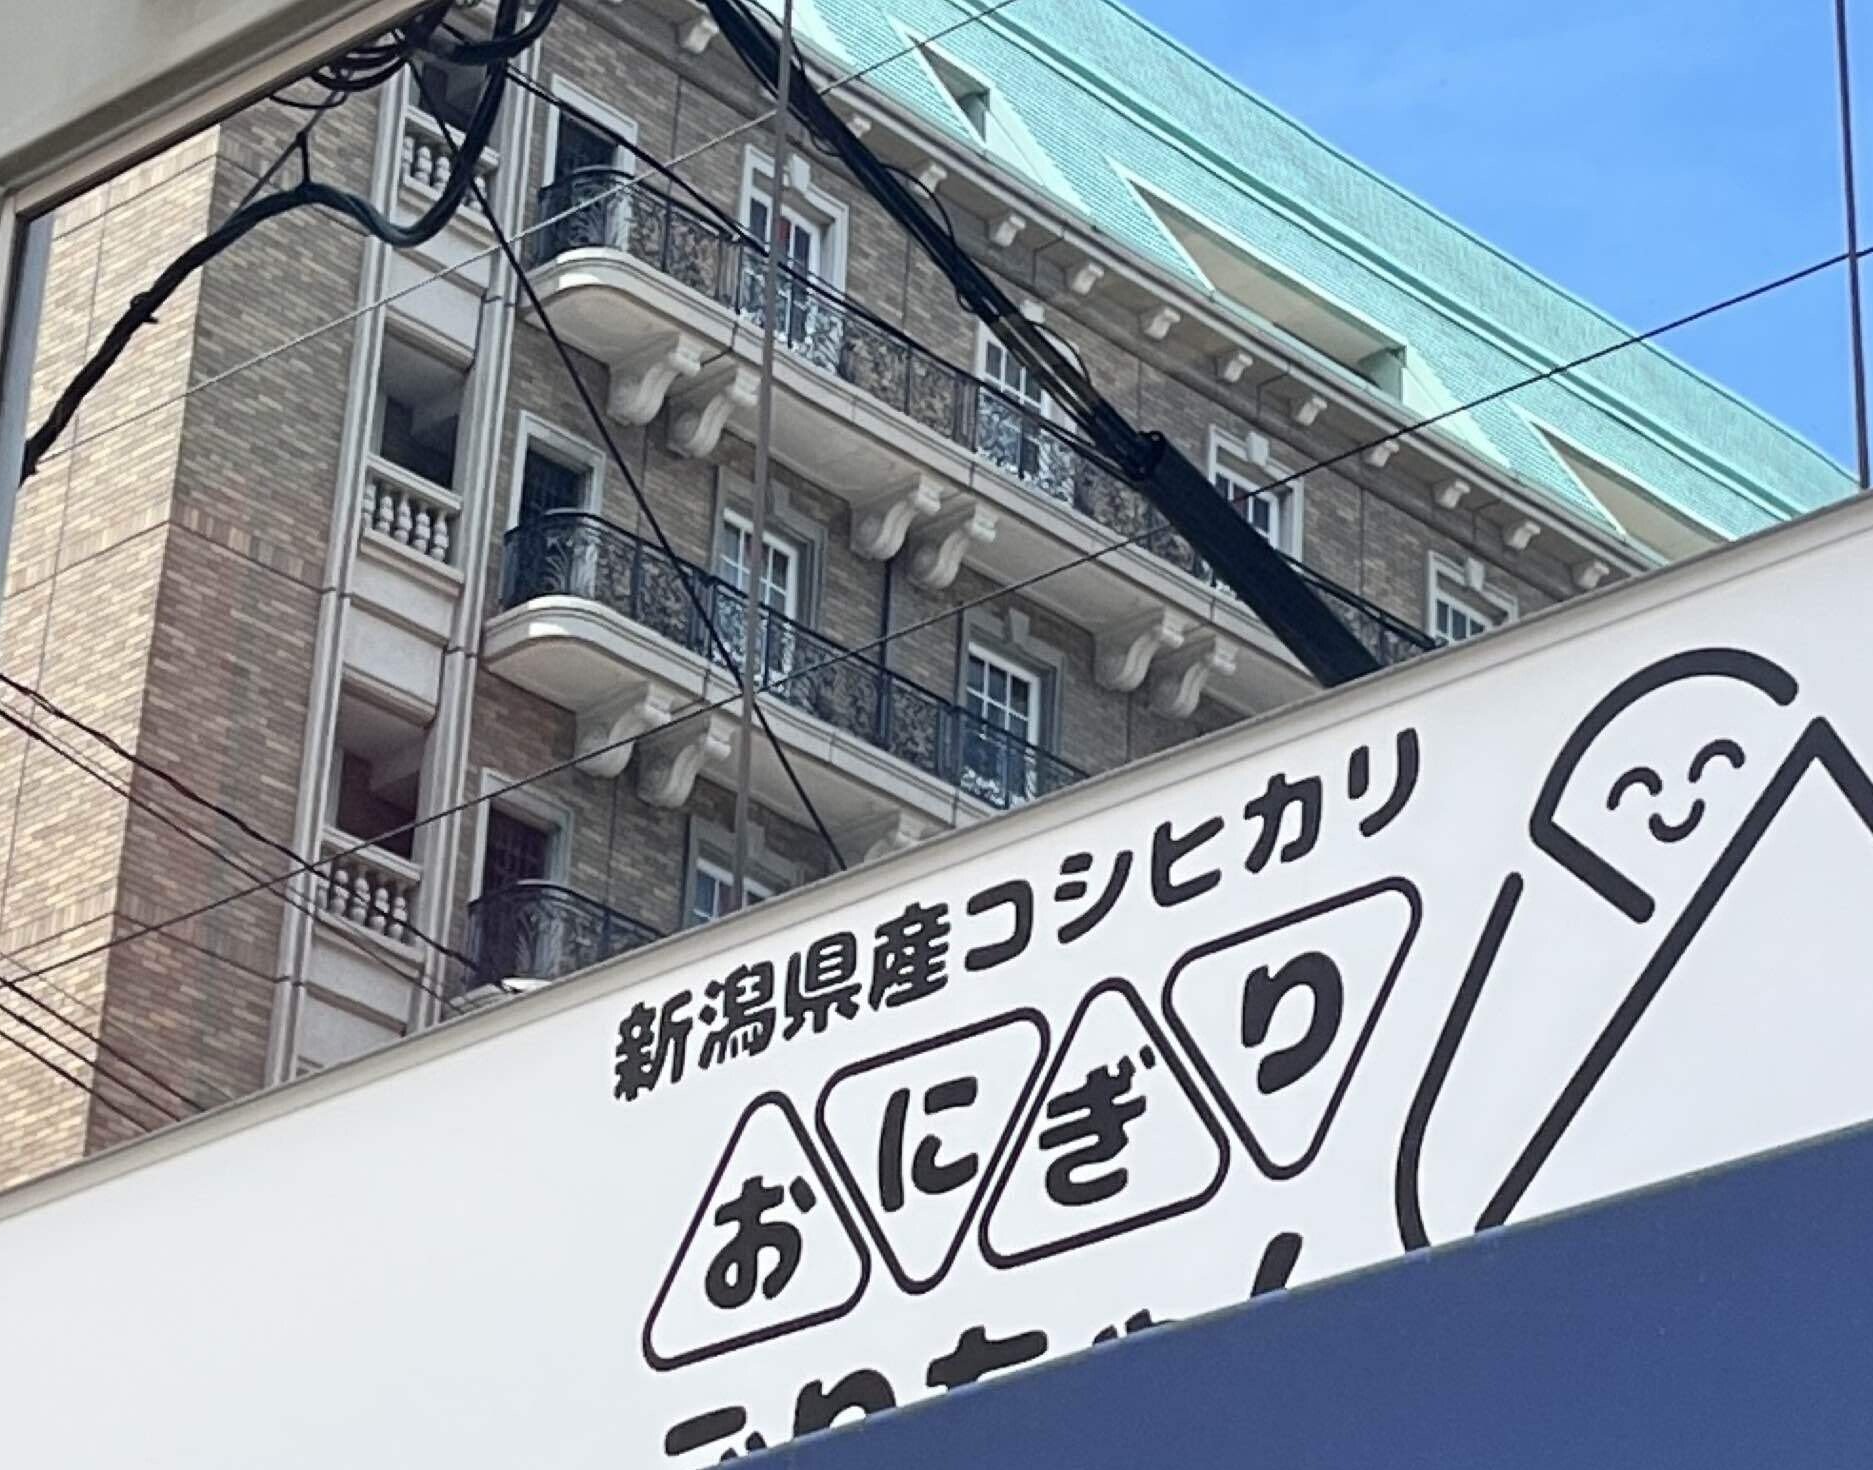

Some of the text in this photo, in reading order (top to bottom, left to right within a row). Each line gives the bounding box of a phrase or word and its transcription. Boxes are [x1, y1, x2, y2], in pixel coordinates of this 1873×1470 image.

[612, 726, 1421, 1103] 新潟県産コシヒカリ
[703, 950, 1345, 1311] おにぎり
